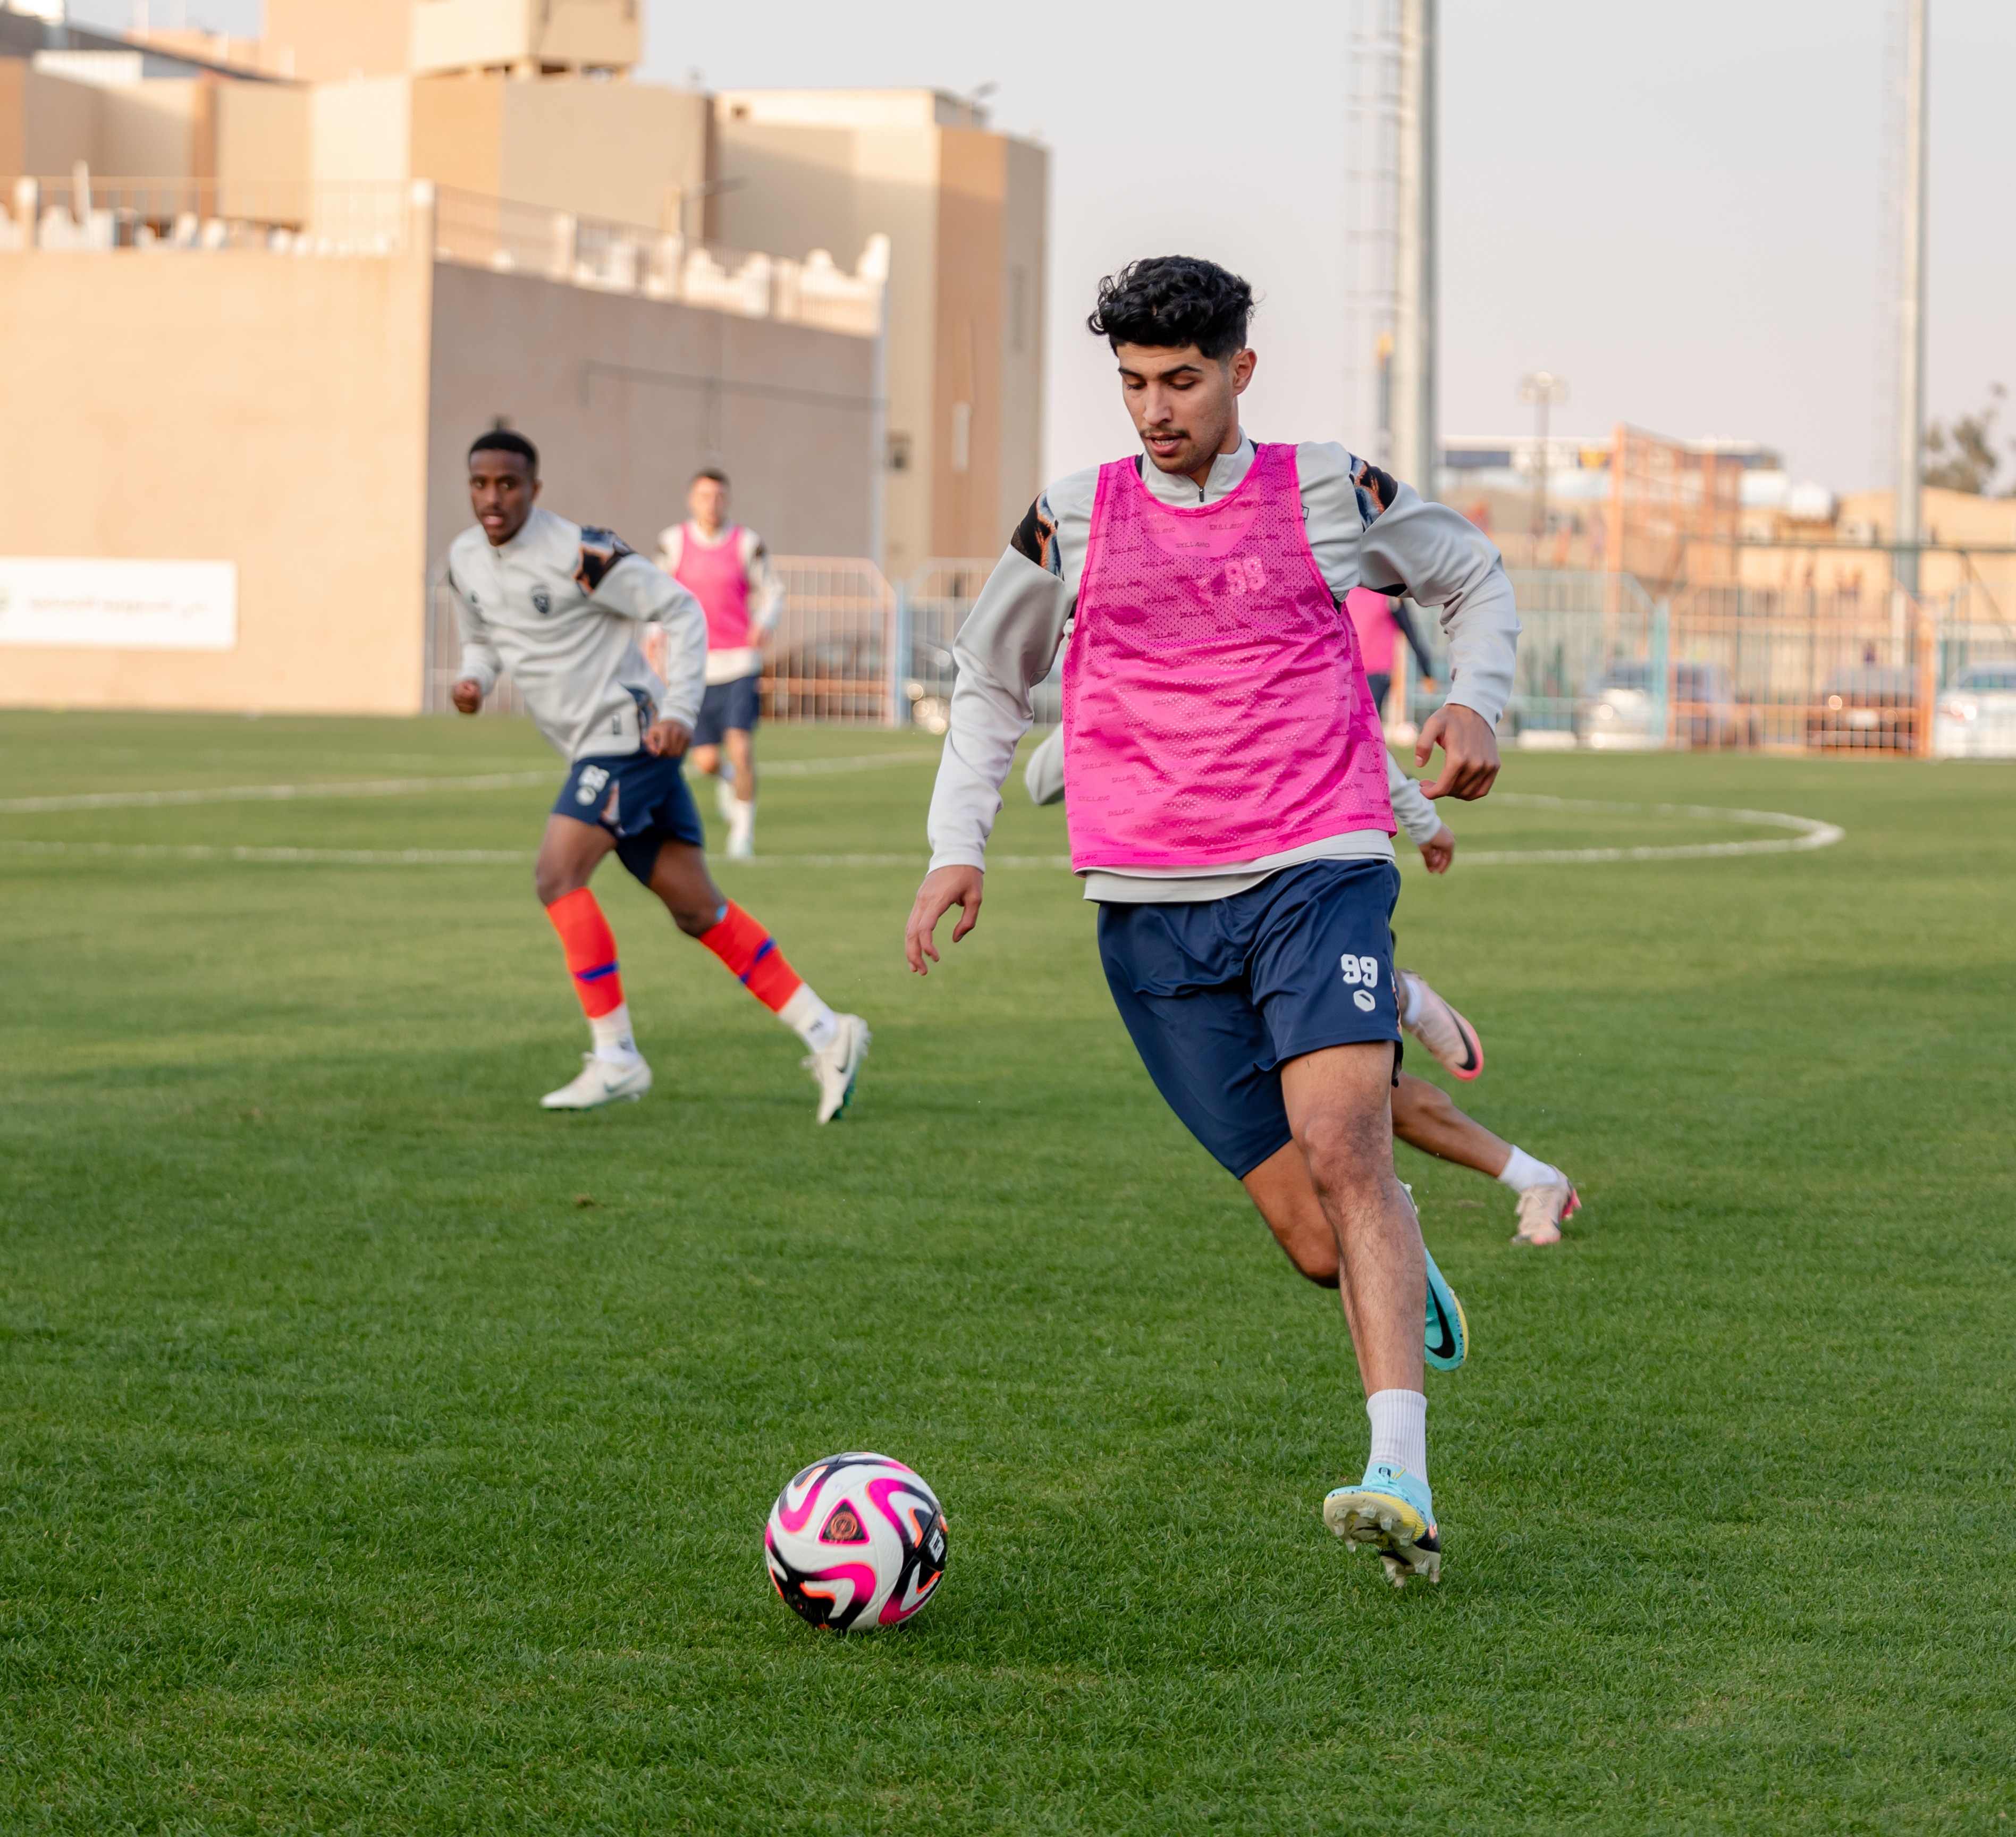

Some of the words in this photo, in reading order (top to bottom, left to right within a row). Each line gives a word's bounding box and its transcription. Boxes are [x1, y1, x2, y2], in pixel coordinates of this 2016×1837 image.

[1082, 761, 1111, 770] SKILLANO
[1108, 808, 1135, 816] SKILLANO
[1340, 954, 1378, 988] 99
